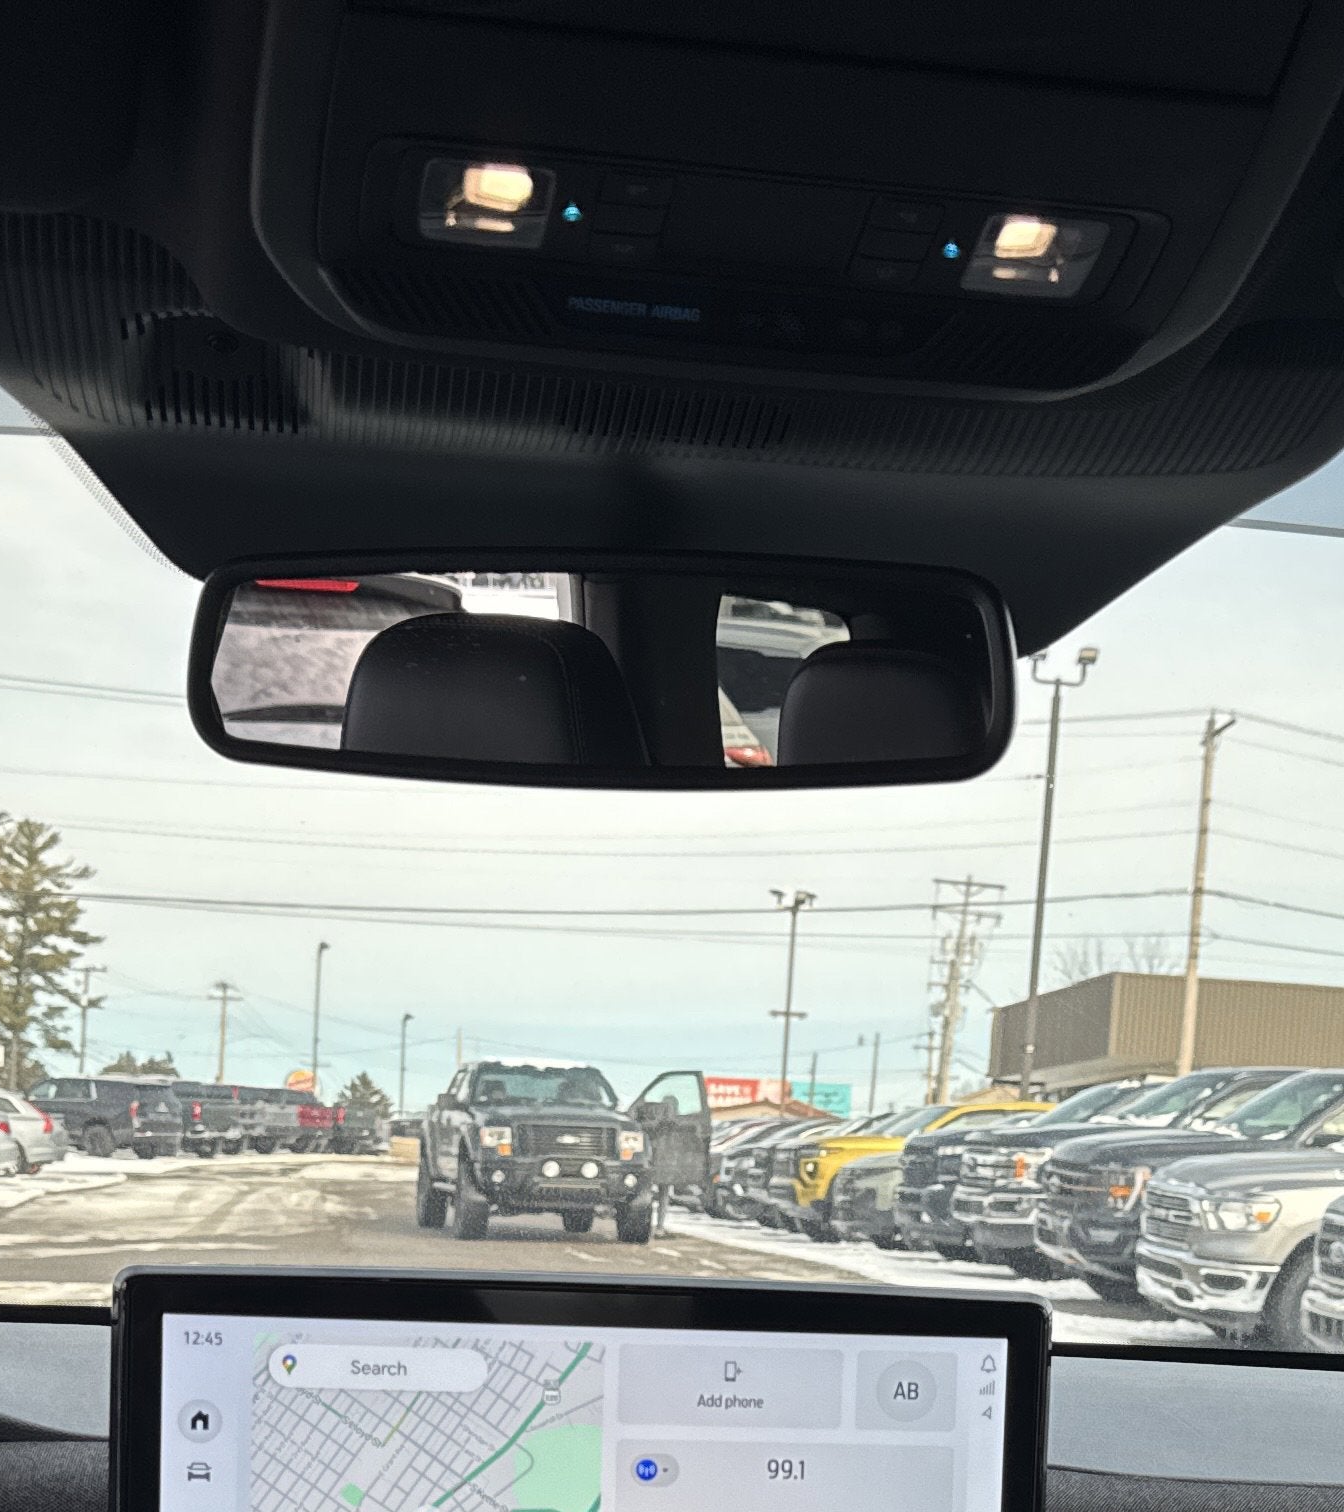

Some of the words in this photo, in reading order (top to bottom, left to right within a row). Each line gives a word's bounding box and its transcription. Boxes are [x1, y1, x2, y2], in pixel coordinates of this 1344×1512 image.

[568, 296, 647, 317] PASSENGER
[651, 305, 701, 322] AIRBAG
[183, 1331, 223, 1346] 12:45
[350, 1359, 408, 1377] Search
[893, 1381, 919, 1401] AB
[697, 1394, 722, 1409] Add
[724, 1395, 765, 1410] phone
[766, 1458, 806, 1481] 99.1
